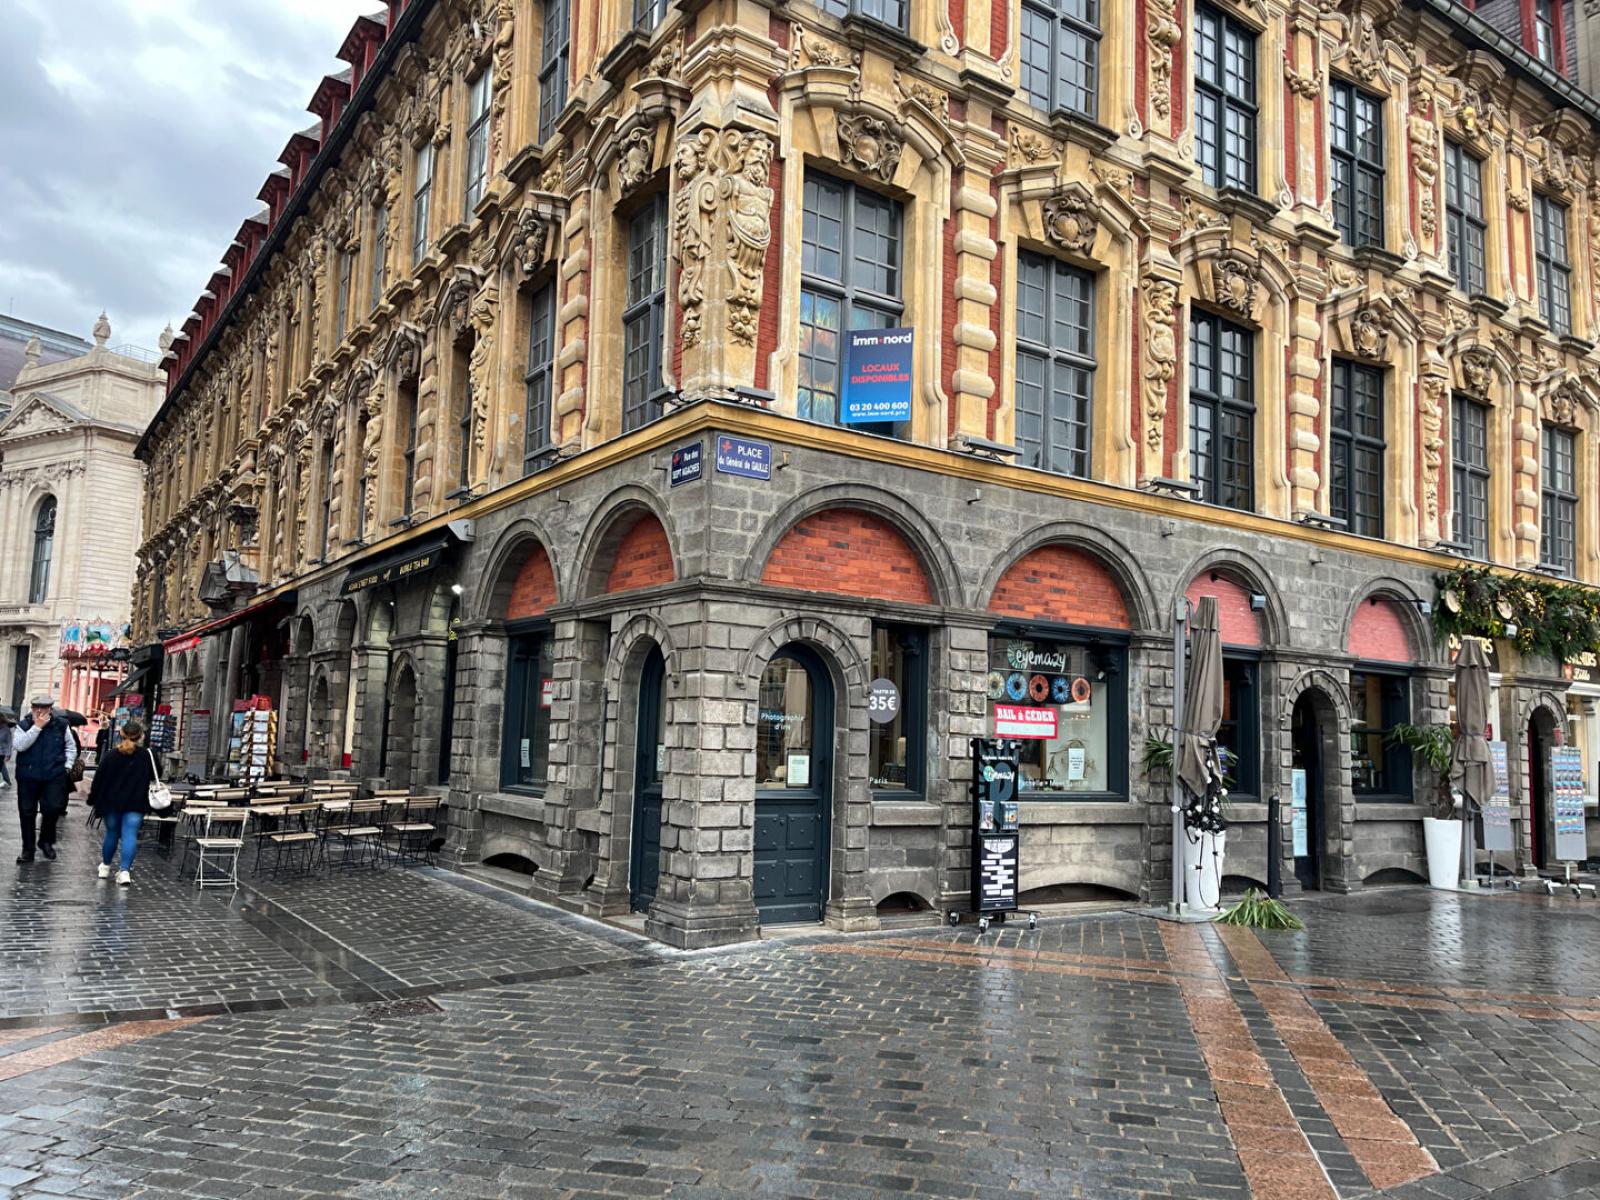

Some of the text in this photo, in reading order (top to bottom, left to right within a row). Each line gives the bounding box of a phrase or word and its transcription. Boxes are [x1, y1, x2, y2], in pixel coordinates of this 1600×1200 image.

[861, 363, 899, 373] LOCAUX
[851, 374, 909, 384] DISPONIBLES
[850, 401, 908, 411] 03 20 400 600
[737, 445, 762, 459] PLACE
[751, 461, 769, 473] GAULLE
[1016, 649, 1066, 673] eyemazy
[869, 696, 896, 711] 35€
[760, 711, 805, 723] Photographie
[997, 707, 1016, 720] BAIL
